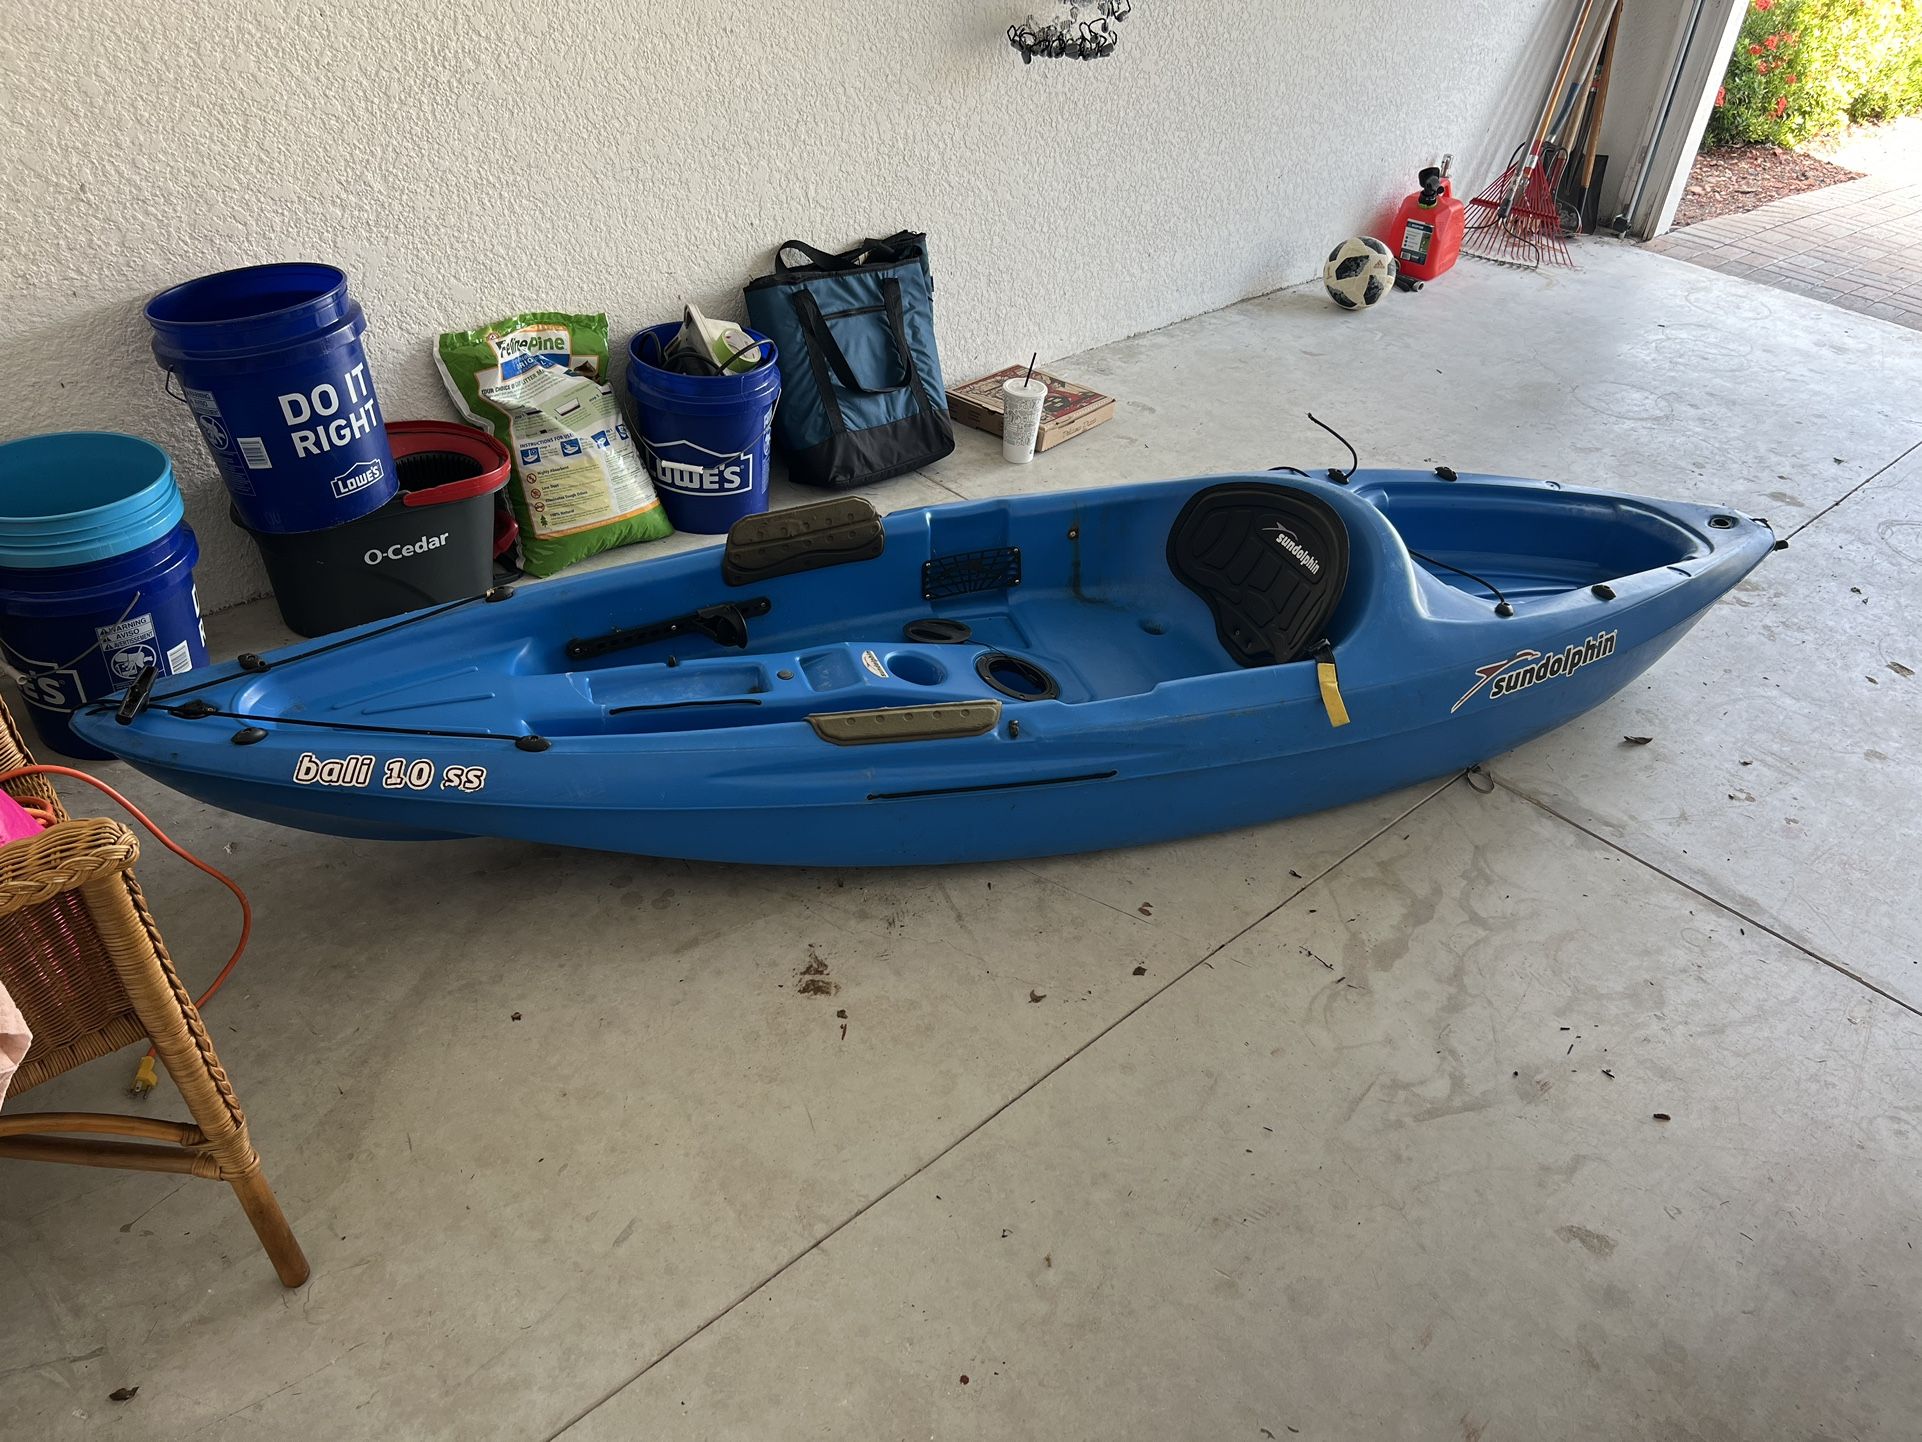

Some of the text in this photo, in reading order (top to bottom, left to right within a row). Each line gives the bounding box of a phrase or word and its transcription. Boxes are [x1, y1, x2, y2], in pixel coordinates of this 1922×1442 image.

[278, 362, 368, 426] DO IT
[291, 398, 377, 458] RIGHT
[520, 437, 554, 449] INSTRUCTIONS
[338, 465, 380, 493] LOWE'S
[364, 532, 449, 565] O-Cedar
[1276, 533, 1320, 575] sundolphin
[114, 631, 154, 648] AVERTISSEMENT
[116, 628, 140, 640] AVISO
[1489, 629, 1618, 700] sundolphin
[293, 752, 487, 792] bali 10 ss
